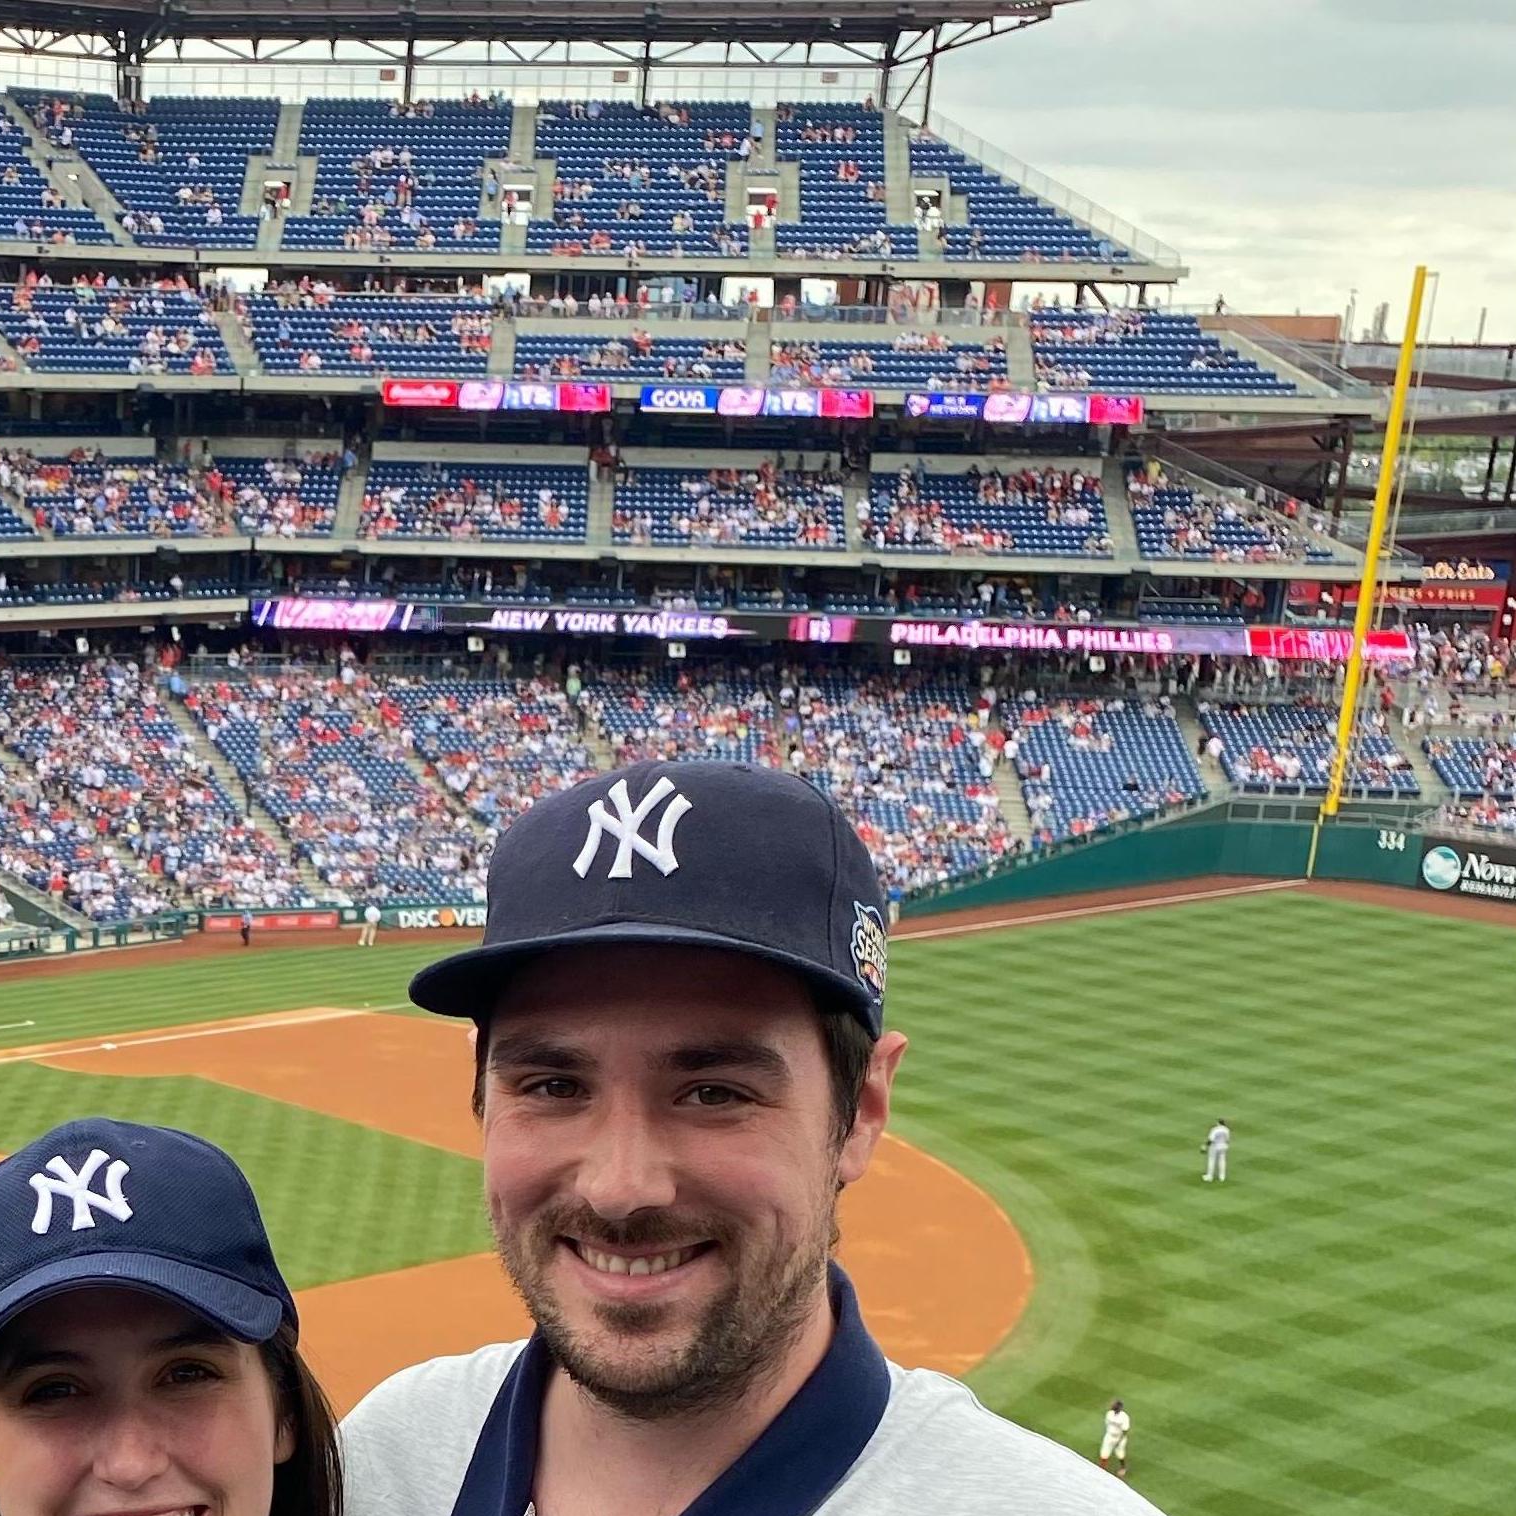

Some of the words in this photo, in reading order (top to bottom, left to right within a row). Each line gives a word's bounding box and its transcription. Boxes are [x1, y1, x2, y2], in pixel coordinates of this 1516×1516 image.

[650, 388, 706, 408] GOYA
[490, 610, 549, 631] NEW
[554, 612, 616, 632] YORK
[622, 613, 729, 637] YANKEES
[891, 623, 1063, 648] PHILADELPHIA
[1067, 629, 1173, 651] PHILLIES
[573, 776, 693, 879] NY
[1377, 829, 1406, 852] 334
[398, 908, 486, 929] DISCOVER
[29, 1148, 134, 1235] NY
